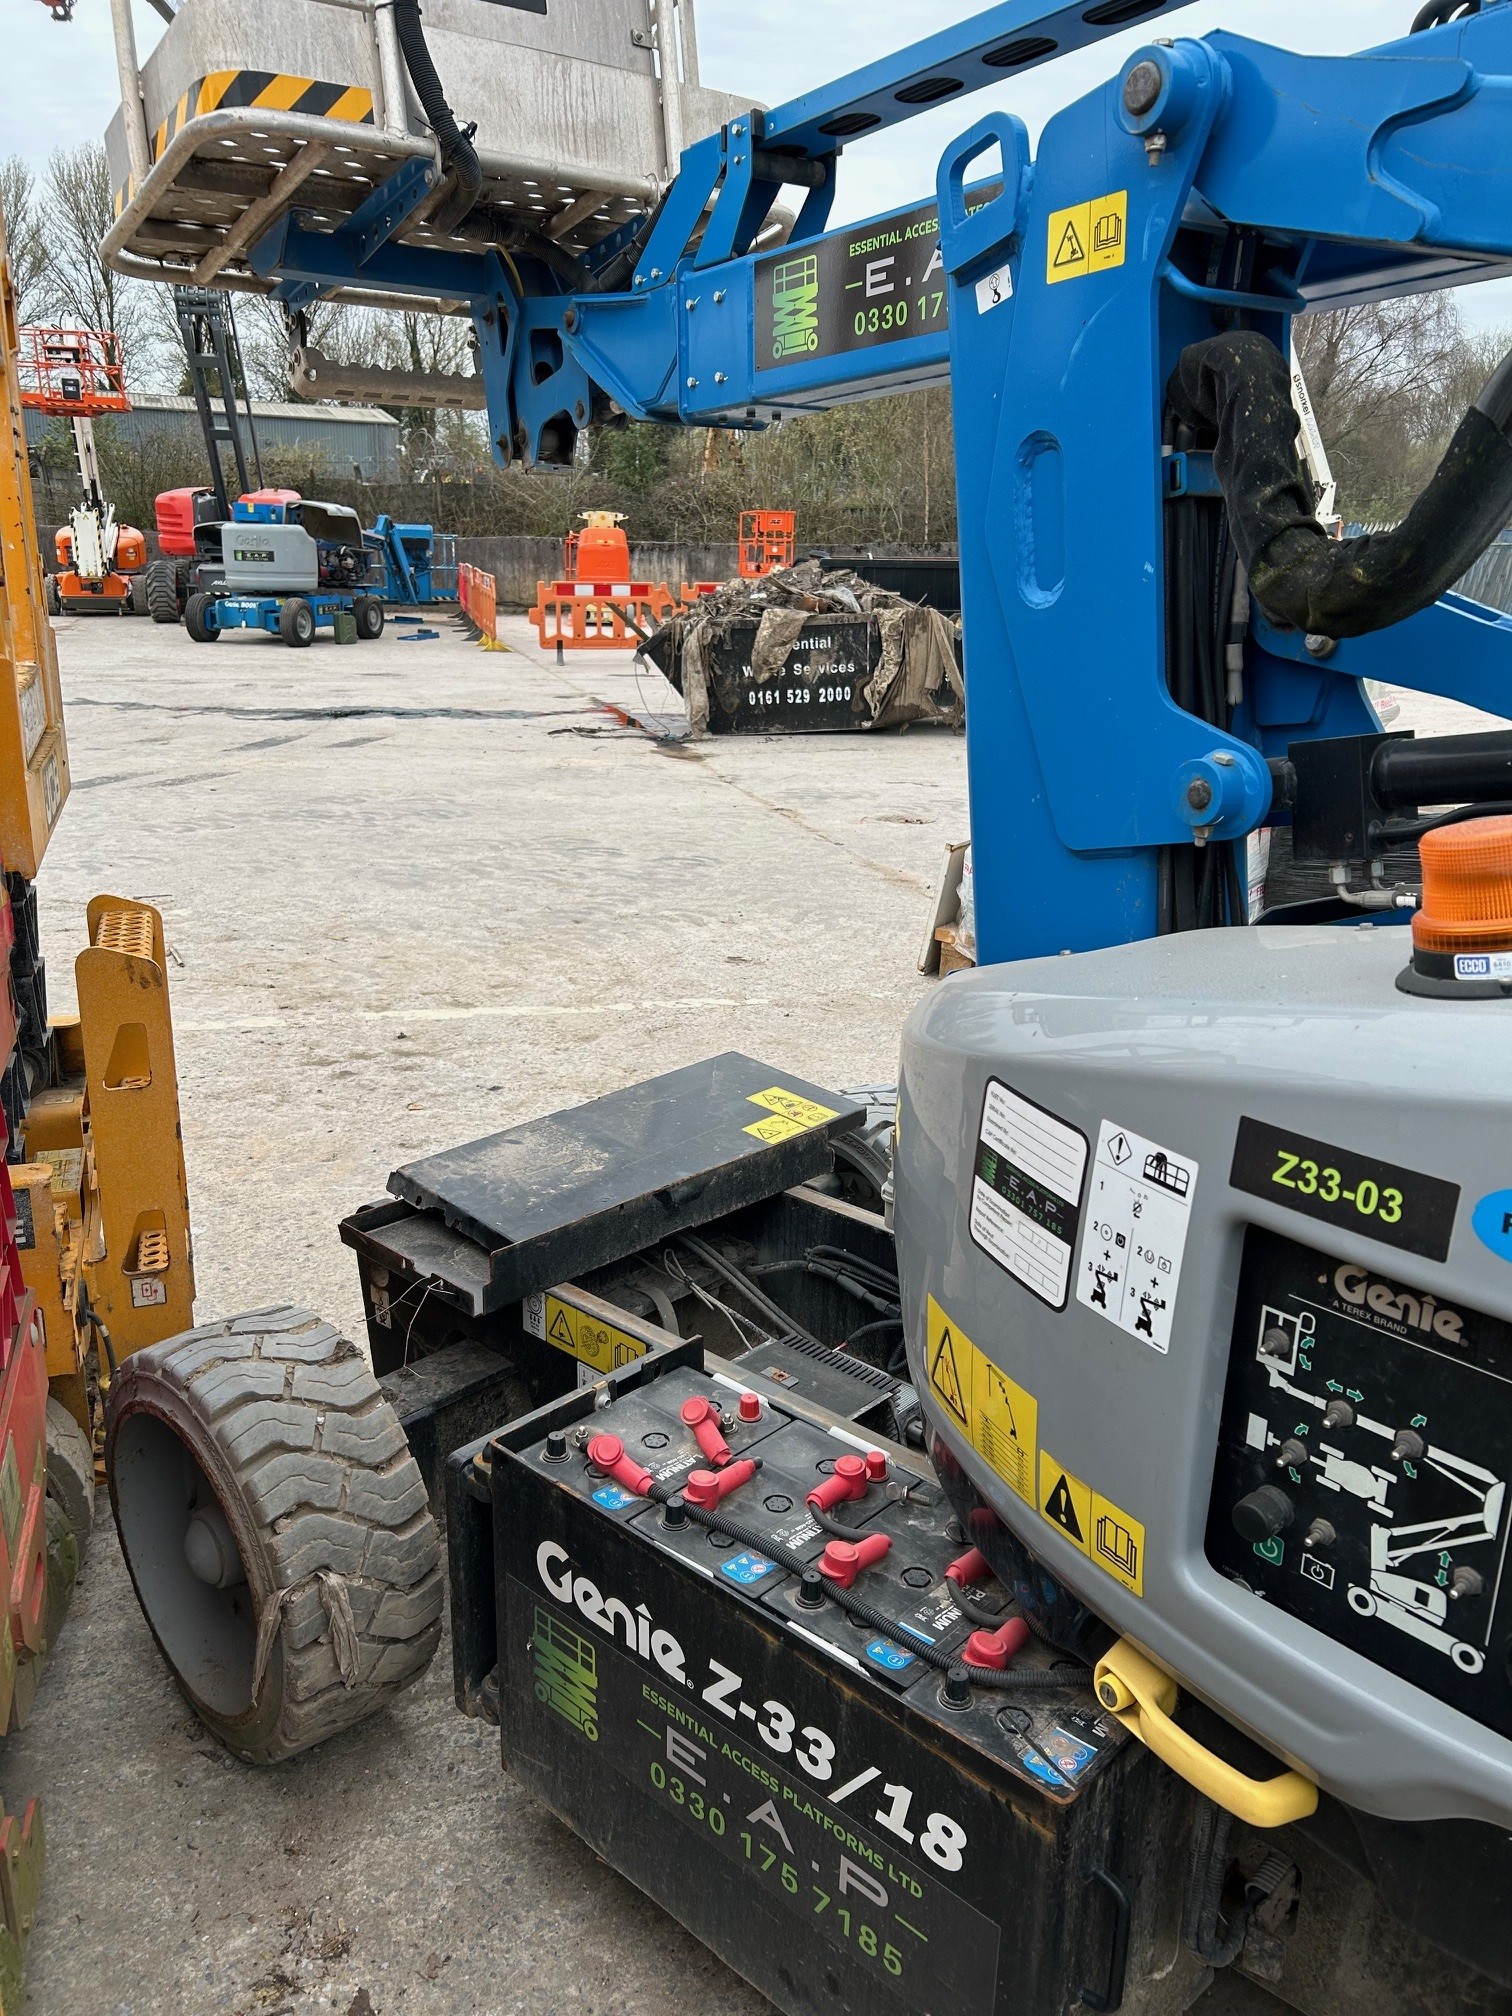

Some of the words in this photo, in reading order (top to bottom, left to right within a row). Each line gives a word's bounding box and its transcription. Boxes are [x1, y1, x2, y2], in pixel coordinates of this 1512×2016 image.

[849, 230, 903, 258] ESSENTIAL
[904, 218, 940, 241] ACCES
[854, 301, 908, 335] 0330
[917, 291, 949, 320] 17
[1295, 381, 1310, 416] snorkel
[793, 636, 832, 650] ential
[793, 662, 855, 676] Sevices
[748, 689, 780, 706] 0161
[786, 688, 811, 704] 529
[818, 686, 852, 703] 2000
[1458, 959, 1487, 973] ECCO
[1271, 1150, 1404, 1223] Z33-03
[1001, 1185, 1025, 1208] 03301
[1028, 1204, 1043, 1220] 757
[1046, 1218, 1062, 1235] 185
[1093, 1221, 1099, 1232] 2
[1087, 1261, 1093, 1272] 3
[1137, 1245, 1143, 1256] 2
[1130, 1287, 1136, 1297] 3
[1334, 1263, 1465, 1344] Genie
[1332, 1300, 1340, 1309] A
[1341, 1302, 1372, 1321] TEREX
[1373, 1315, 1408, 1335] BRAND
[655, 1453, 704, 1482] LATINUM
[536, 1540, 687, 1685] Genie
[701, 1657, 968, 1872] Z-33/18
[642, 1684, 719, 1749] ESSENTIAL
[721, 1743, 779, 1793] ACCESS
[783, 1786, 884, 1871] PLATFORMS
[888, 1865, 923, 1899] LTD
[650, 1761, 727, 1836] 0330
[740, 1832, 799, 1894] 175
[812, 1885, 903, 1976] 7185
